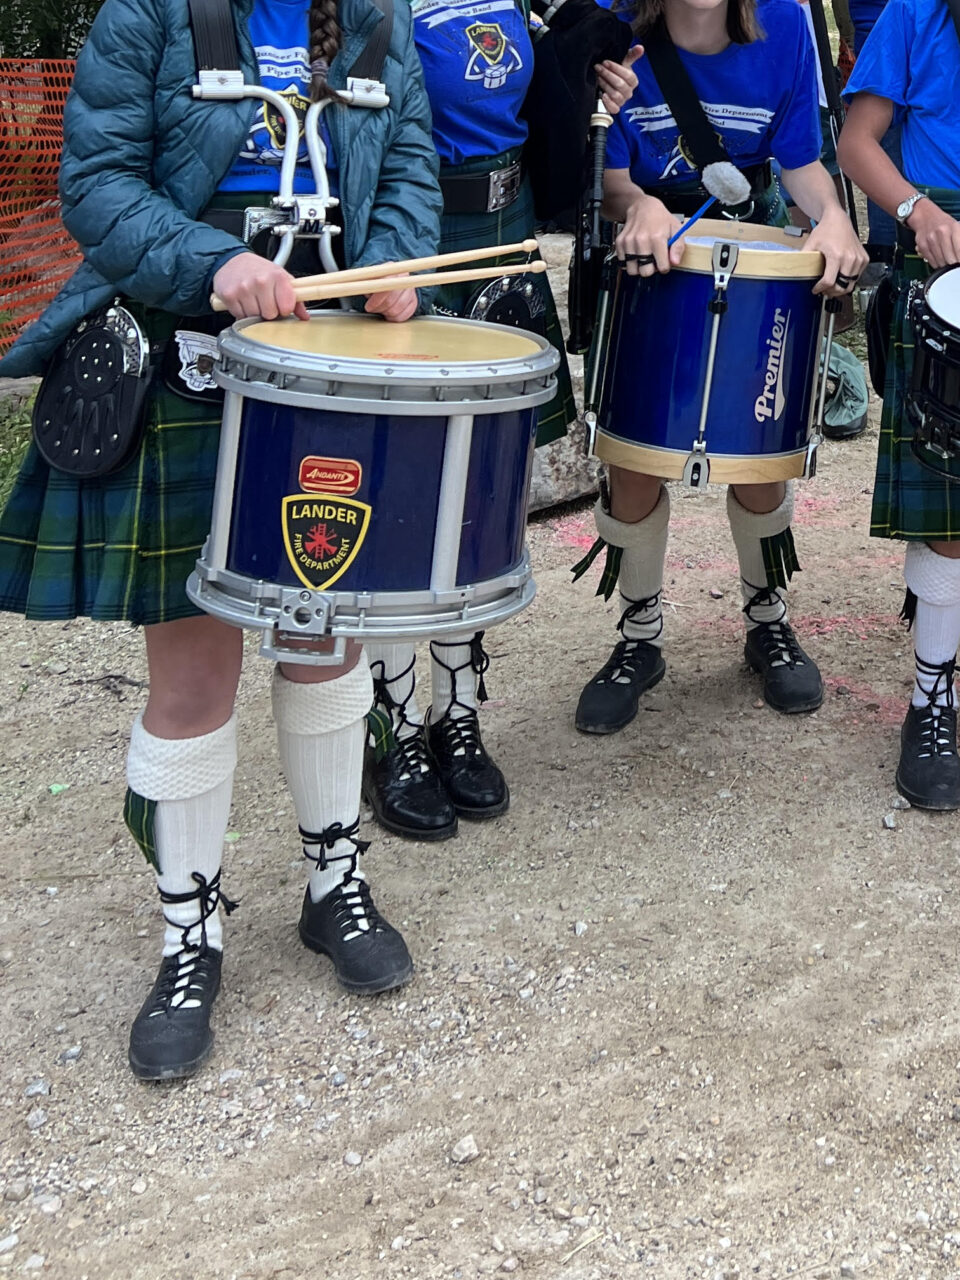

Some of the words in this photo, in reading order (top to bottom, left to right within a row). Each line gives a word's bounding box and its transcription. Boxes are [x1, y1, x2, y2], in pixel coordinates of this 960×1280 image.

[754, 307, 789, 423] Premier
[292, 504, 357, 526] LANDER
[293, 533, 303, 555] FIRE
[300, 537, 351, 570] DEPARTMENT
